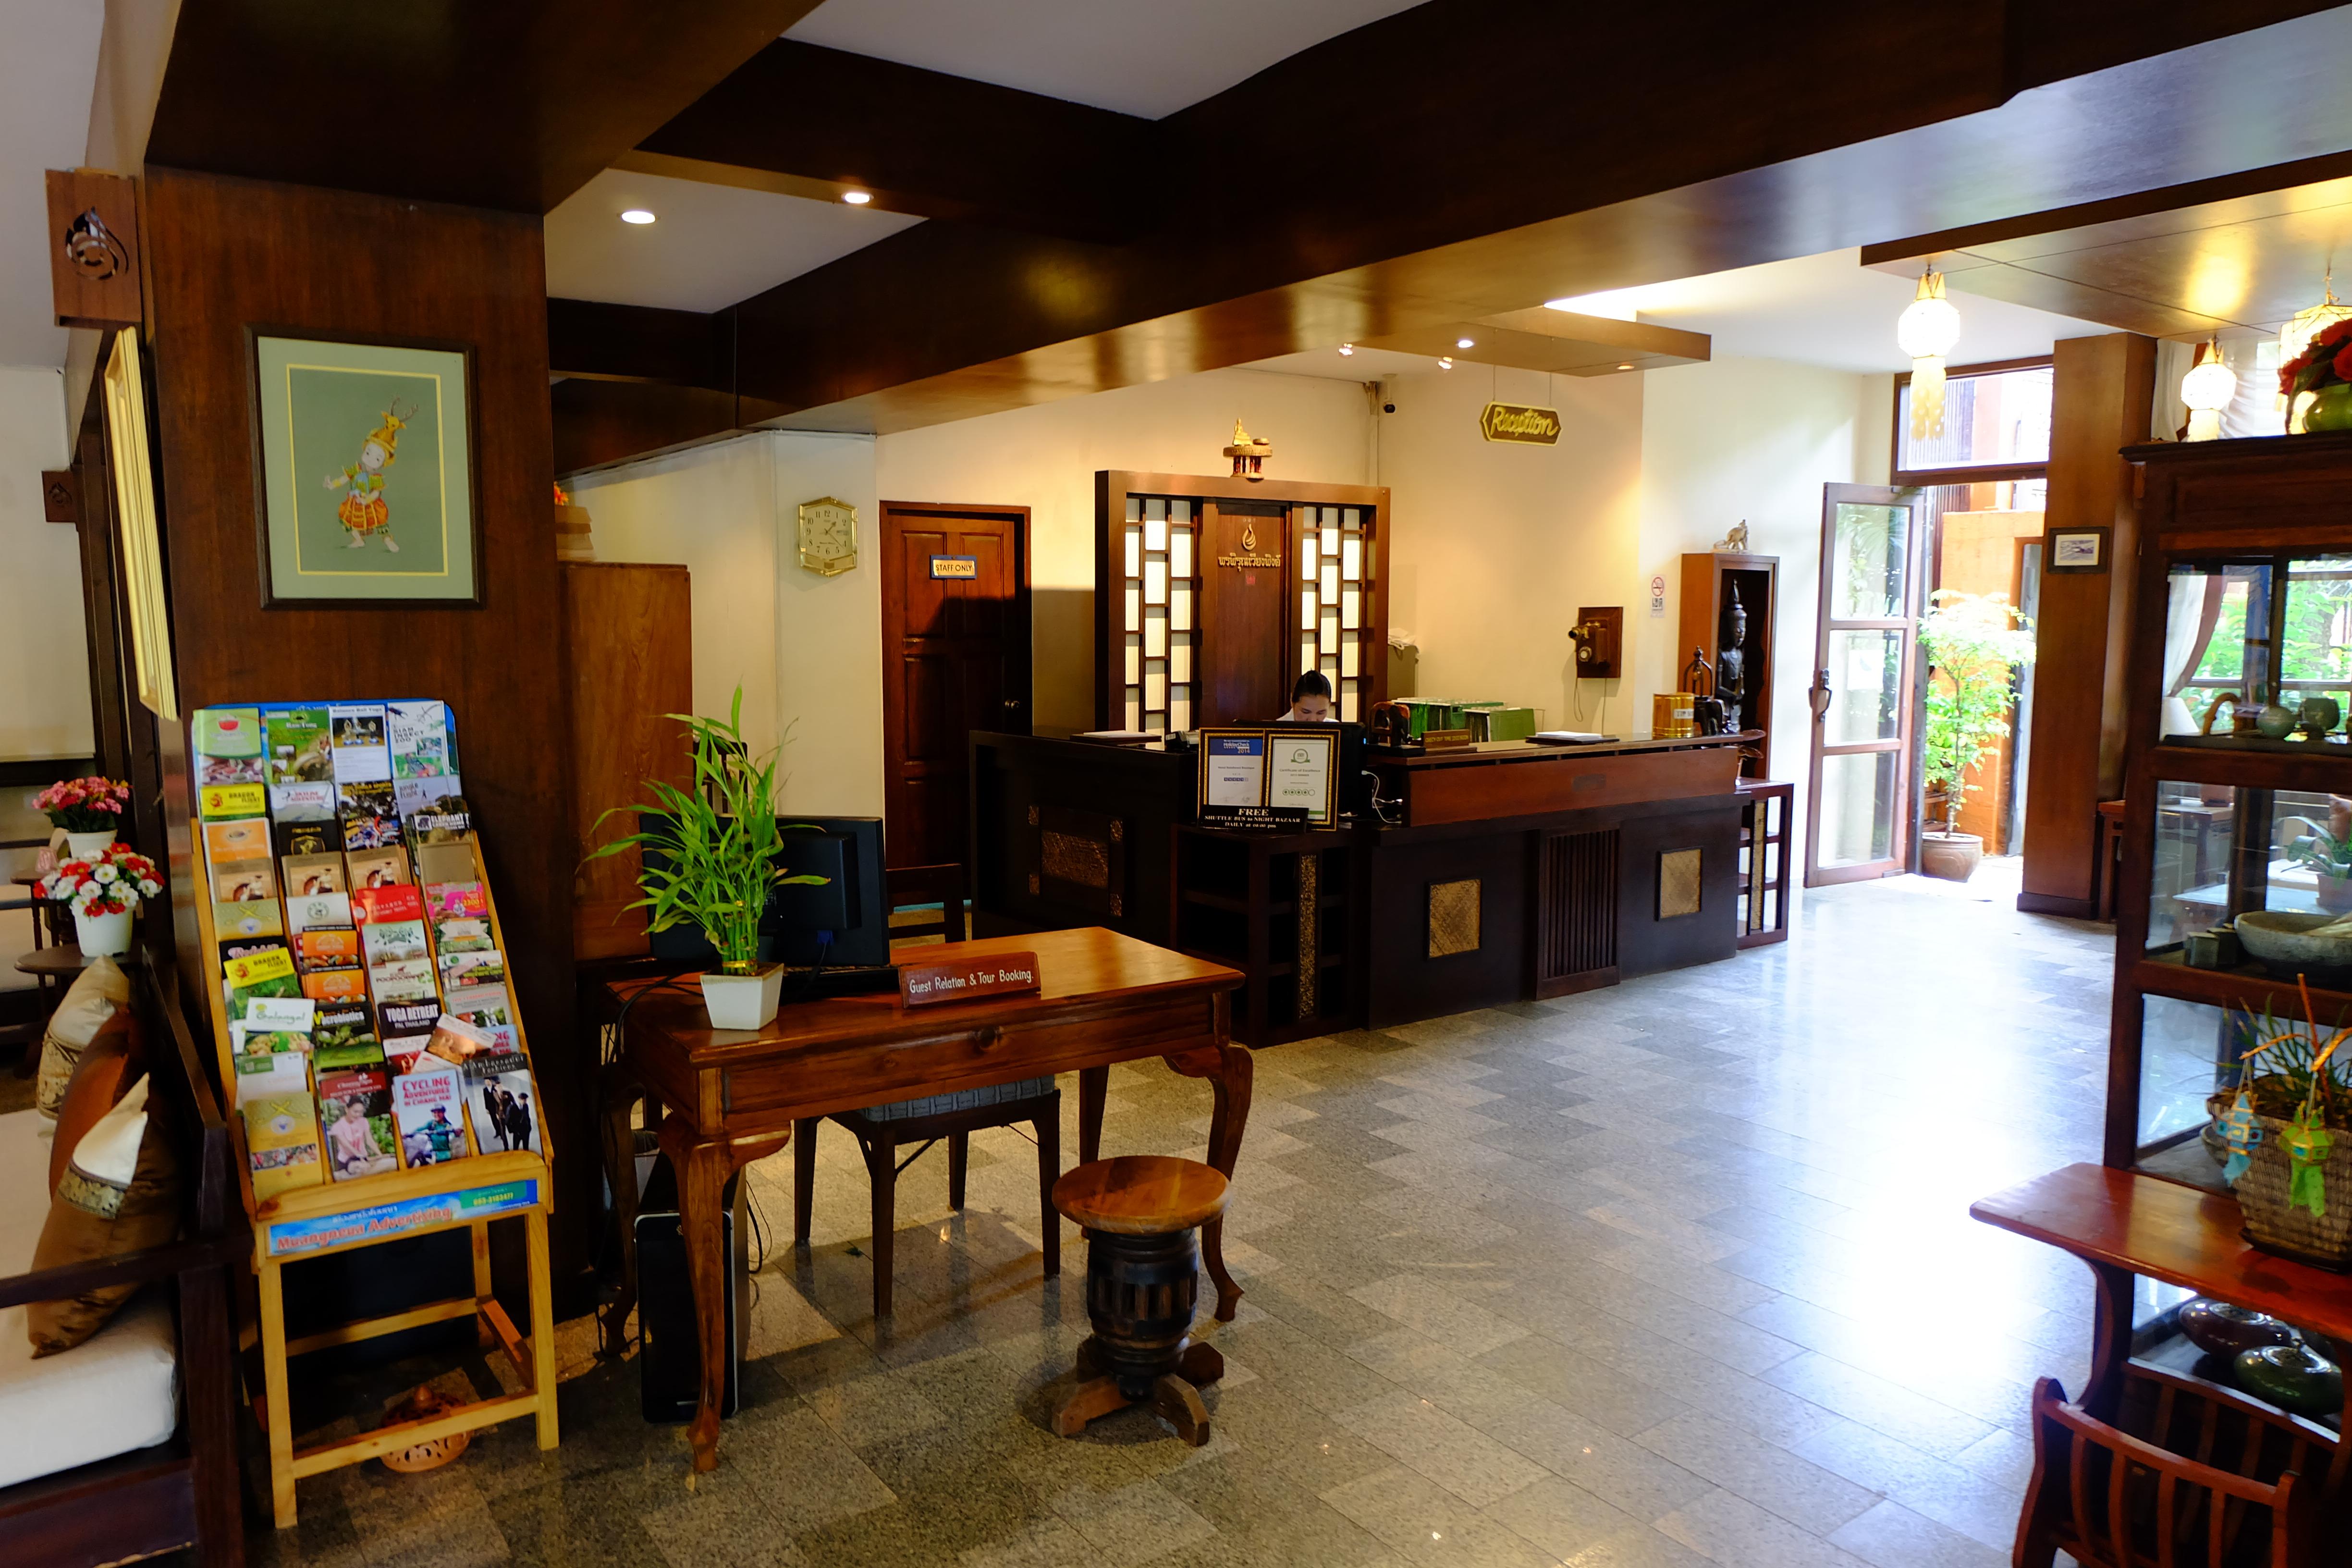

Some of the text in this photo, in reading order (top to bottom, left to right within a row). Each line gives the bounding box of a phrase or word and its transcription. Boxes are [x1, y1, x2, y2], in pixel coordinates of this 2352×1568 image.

[1490, 406, 1559, 437] Reception
[394, 730, 425, 739] INSECT
[909, 969, 1032, 993] Guest Relation & Tour Booking
[385, 1004, 439, 1023] YOGA RETREAT
[403, 1076, 450, 1092] CYCLING
[404, 1087, 450, 1099] ADVENTURES
[412, 1097, 438, 1105] CHIANG
[277, 1224, 366, 1250] Muangneua
[368, 1207, 452, 1233] Advertising
